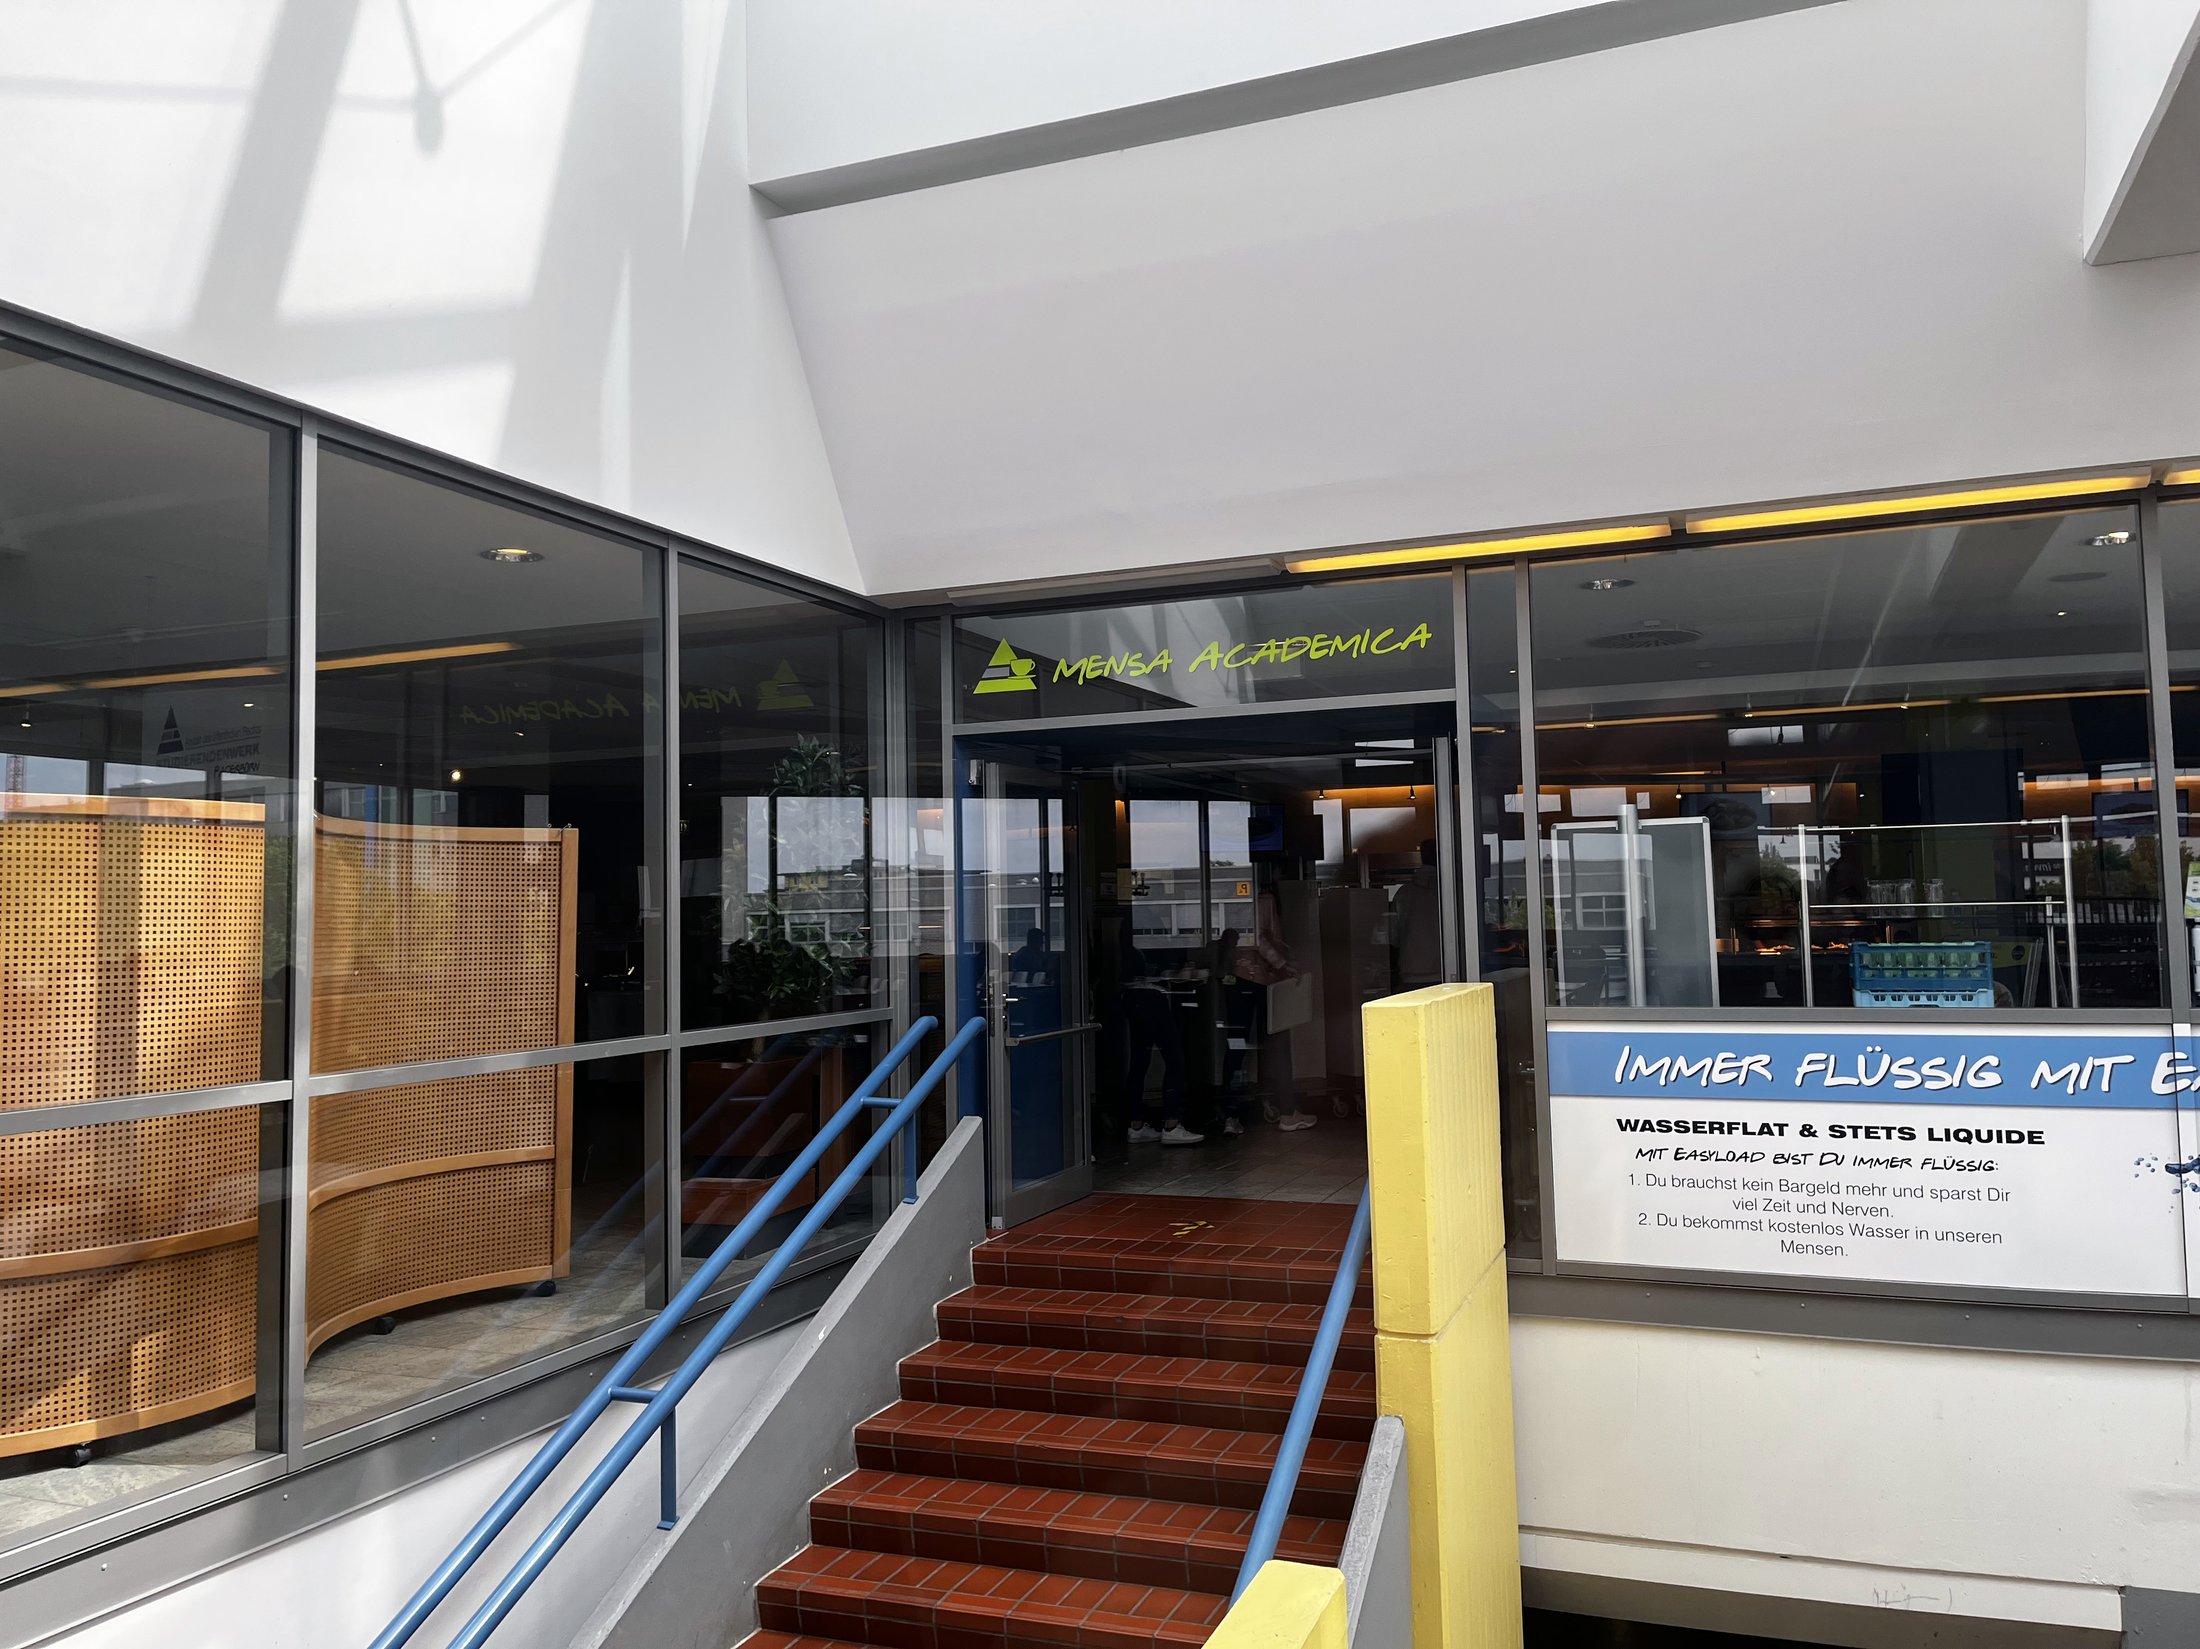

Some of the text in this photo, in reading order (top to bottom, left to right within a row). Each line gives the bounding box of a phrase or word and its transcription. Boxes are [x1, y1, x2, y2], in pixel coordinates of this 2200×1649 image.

[1052, 622, 1433, 685] MENSA ACADEMICA
[1615, 1046, 2200, 1096] IMMER FLÜSSIG MIT E
[1616, 1119, 2045, 1144] WASSERFLAT & STETS LIQUIDE
[1636, 1148, 1998, 1172] MIT EASYLOAD BIST DU IMMER FLÜSSIG:
[1628, 1173, 2011, 1203] 1. Du brauchst kein Bargeld mehr und sparst Dir
[1732, 1198, 1894, 1217] viel Zeit und Nerven.
[1638, 1213, 2002, 1244] 2. Du bekommst kostenlos Wasser in unseren
[1780, 1239, 1849, 1257] Mensen.
